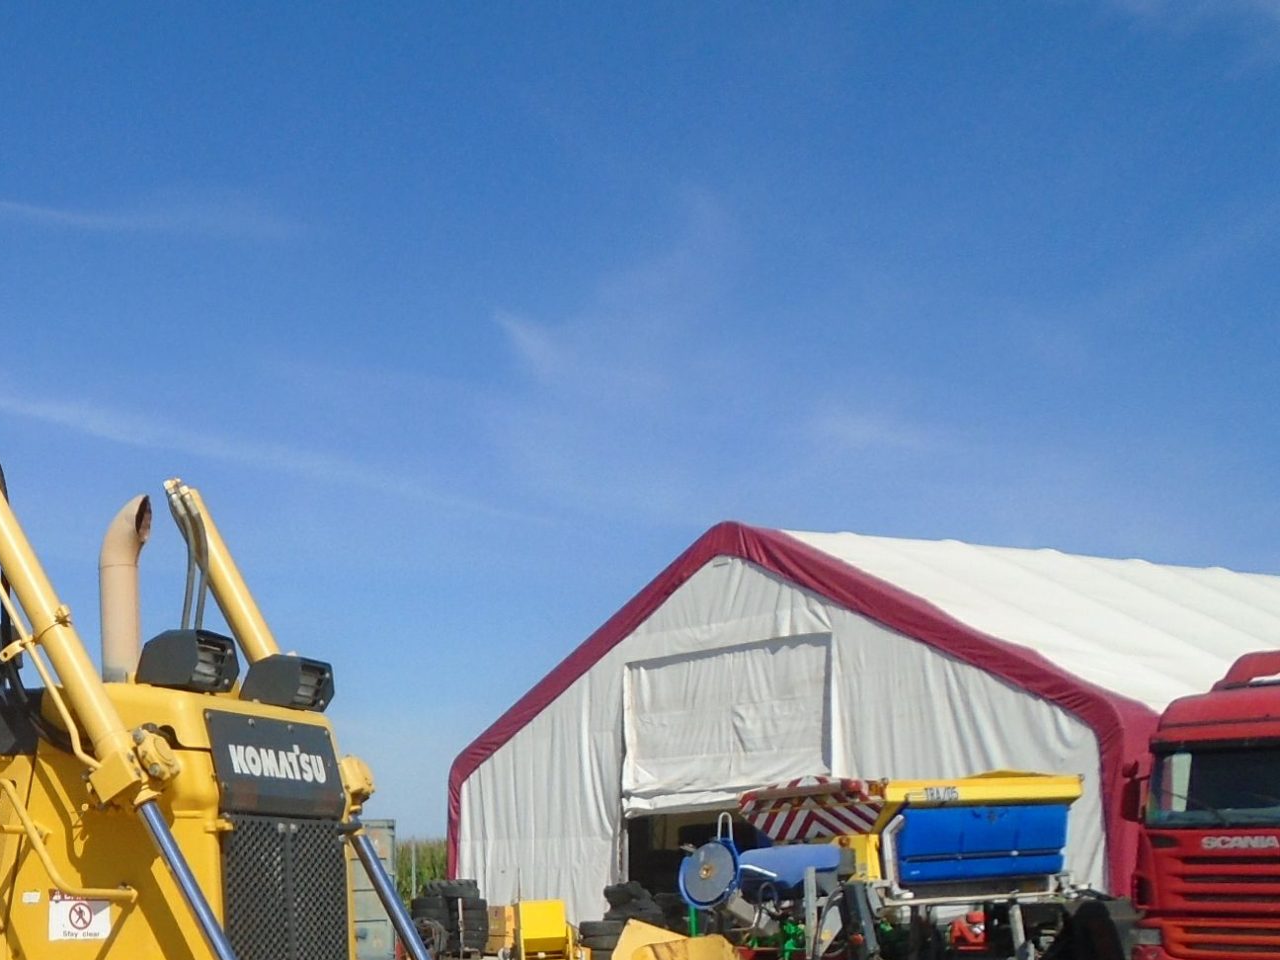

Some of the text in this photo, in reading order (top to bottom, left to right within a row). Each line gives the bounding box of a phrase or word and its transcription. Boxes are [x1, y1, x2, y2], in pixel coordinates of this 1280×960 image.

[228, 744, 327, 784] KOMATSU
[1201, 835, 1280, 850] SCANIA
[62, 930, 78, 938] Stay
